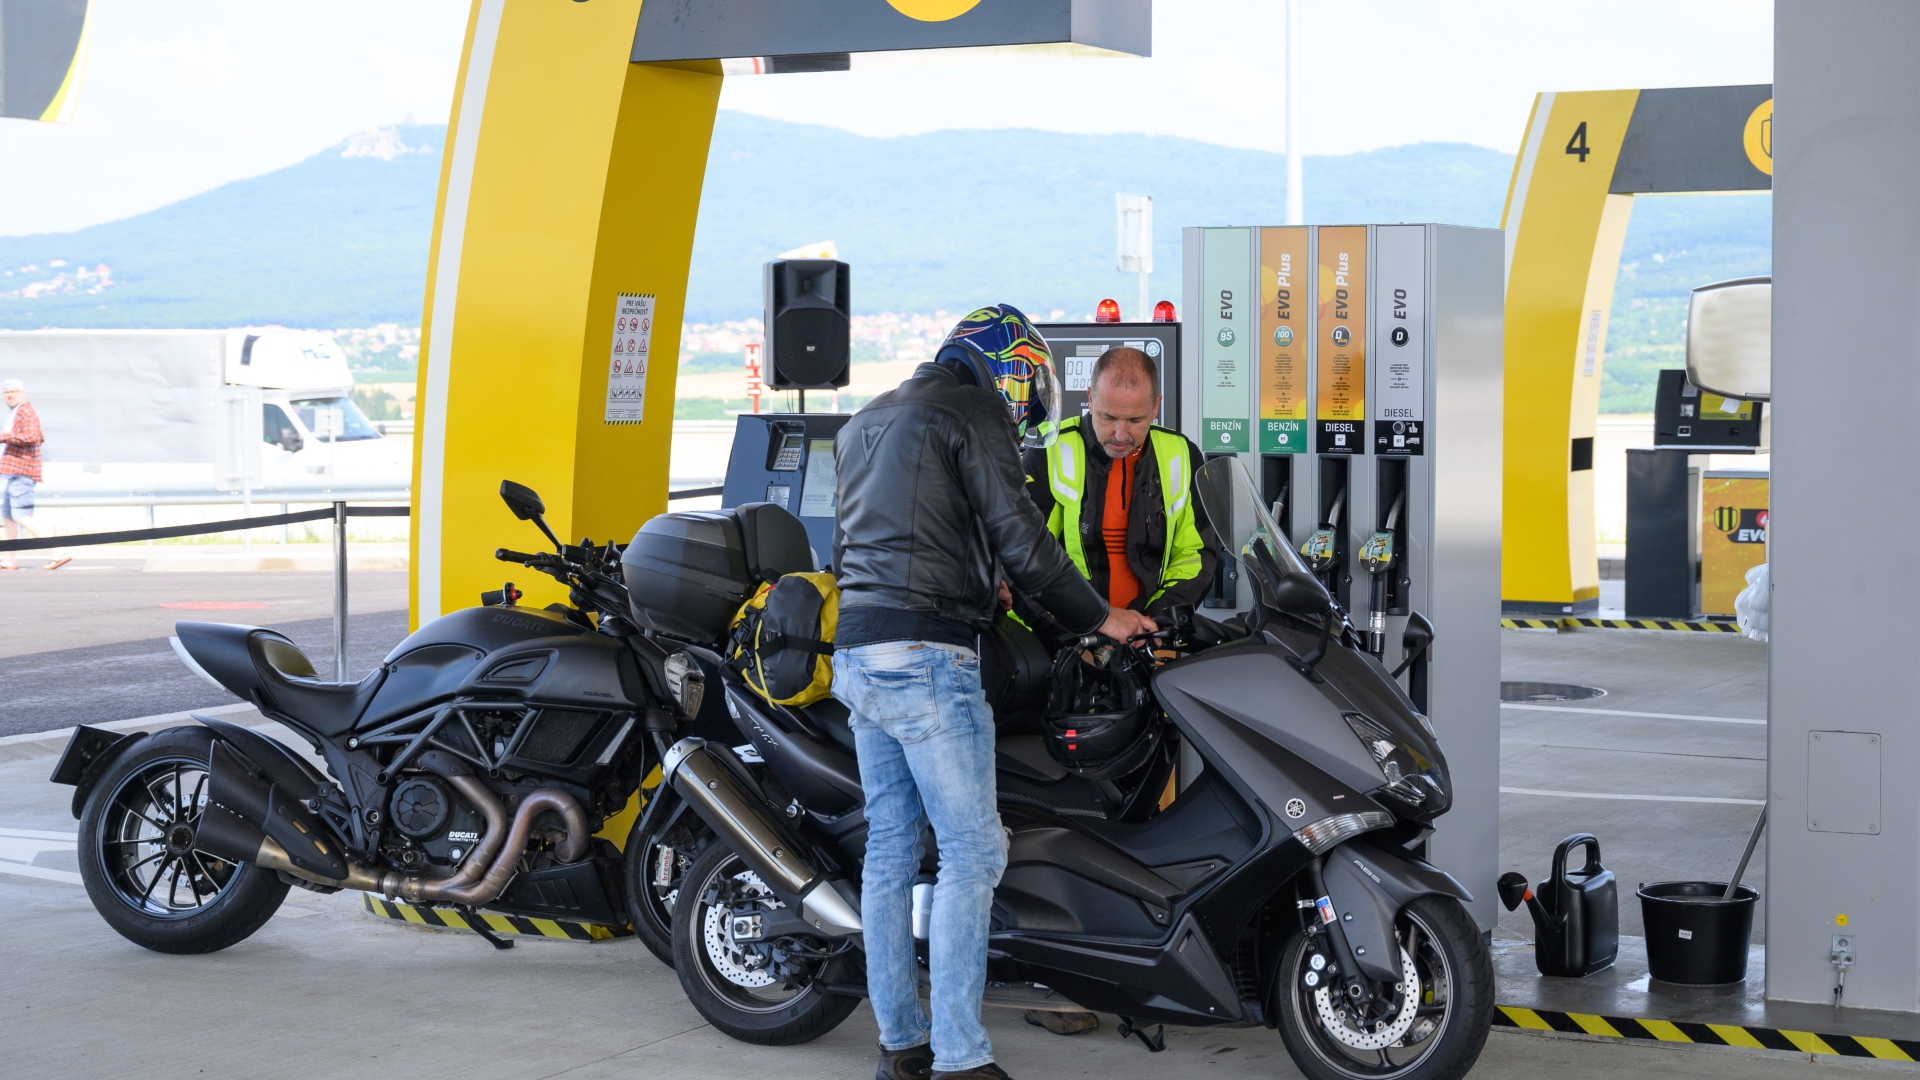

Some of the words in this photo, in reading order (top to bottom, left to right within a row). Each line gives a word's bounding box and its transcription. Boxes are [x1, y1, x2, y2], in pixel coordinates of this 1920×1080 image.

[1565, 121, 1590, 162] 4
[1277, 253, 1290, 287] Plus
[1335, 252, 1348, 287] Plus
[635, 299, 647, 307] VAŠU
[1220, 290, 1233, 320] EVO
[1277, 289, 1290, 320] EVO
[1335, 289, 1348, 320] EVO
[1393, 288, 1407, 320] EVO
[621, 307, 649, 315] BEZPEČNOSŤ
[1220, 331, 1232, 341] 95
[1335, 330, 1342, 339] D
[1396, 331, 1403, 341] D
[1384, 408, 1414, 417] DIESEL
[1210, 420, 1241, 431] BENZÍN
[1267, 420, 1299, 431] BENZÍN
[1325, 423, 1356, 432] DIESEL
[492, 613, 546, 633] DUCATI
[448, 831, 478, 839] DUCATI
[662, 850, 671, 881] brembo
[1353, 860, 1382, 884] ABS
